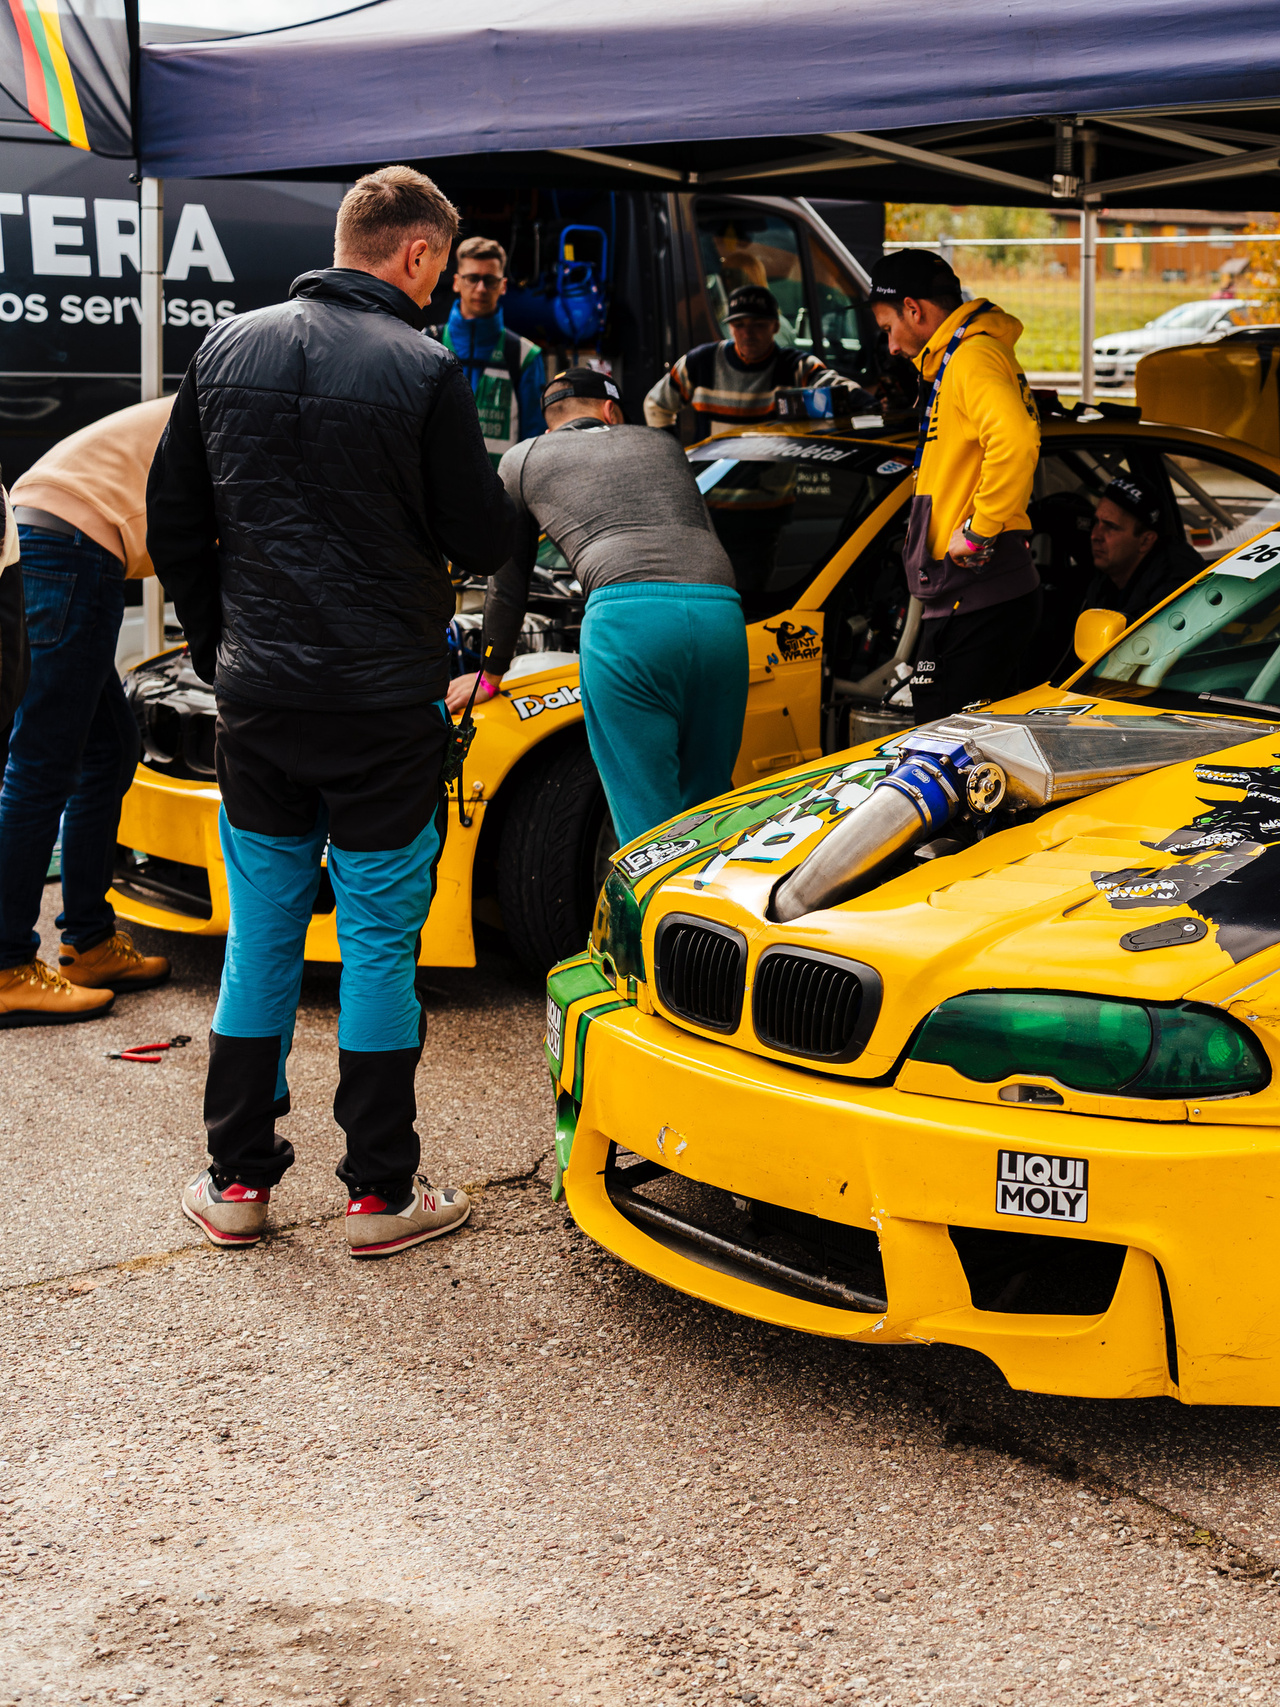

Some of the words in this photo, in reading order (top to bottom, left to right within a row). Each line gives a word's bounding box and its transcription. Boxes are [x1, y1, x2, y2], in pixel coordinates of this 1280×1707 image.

[781, 647, 821, 662] WRAP
[786, 636, 816, 651] TINT
[1001, 1152, 1085, 1188] LIQUI
[422, 1191, 438, 1213] N
[1000, 1184, 1085, 1218] MOLY
